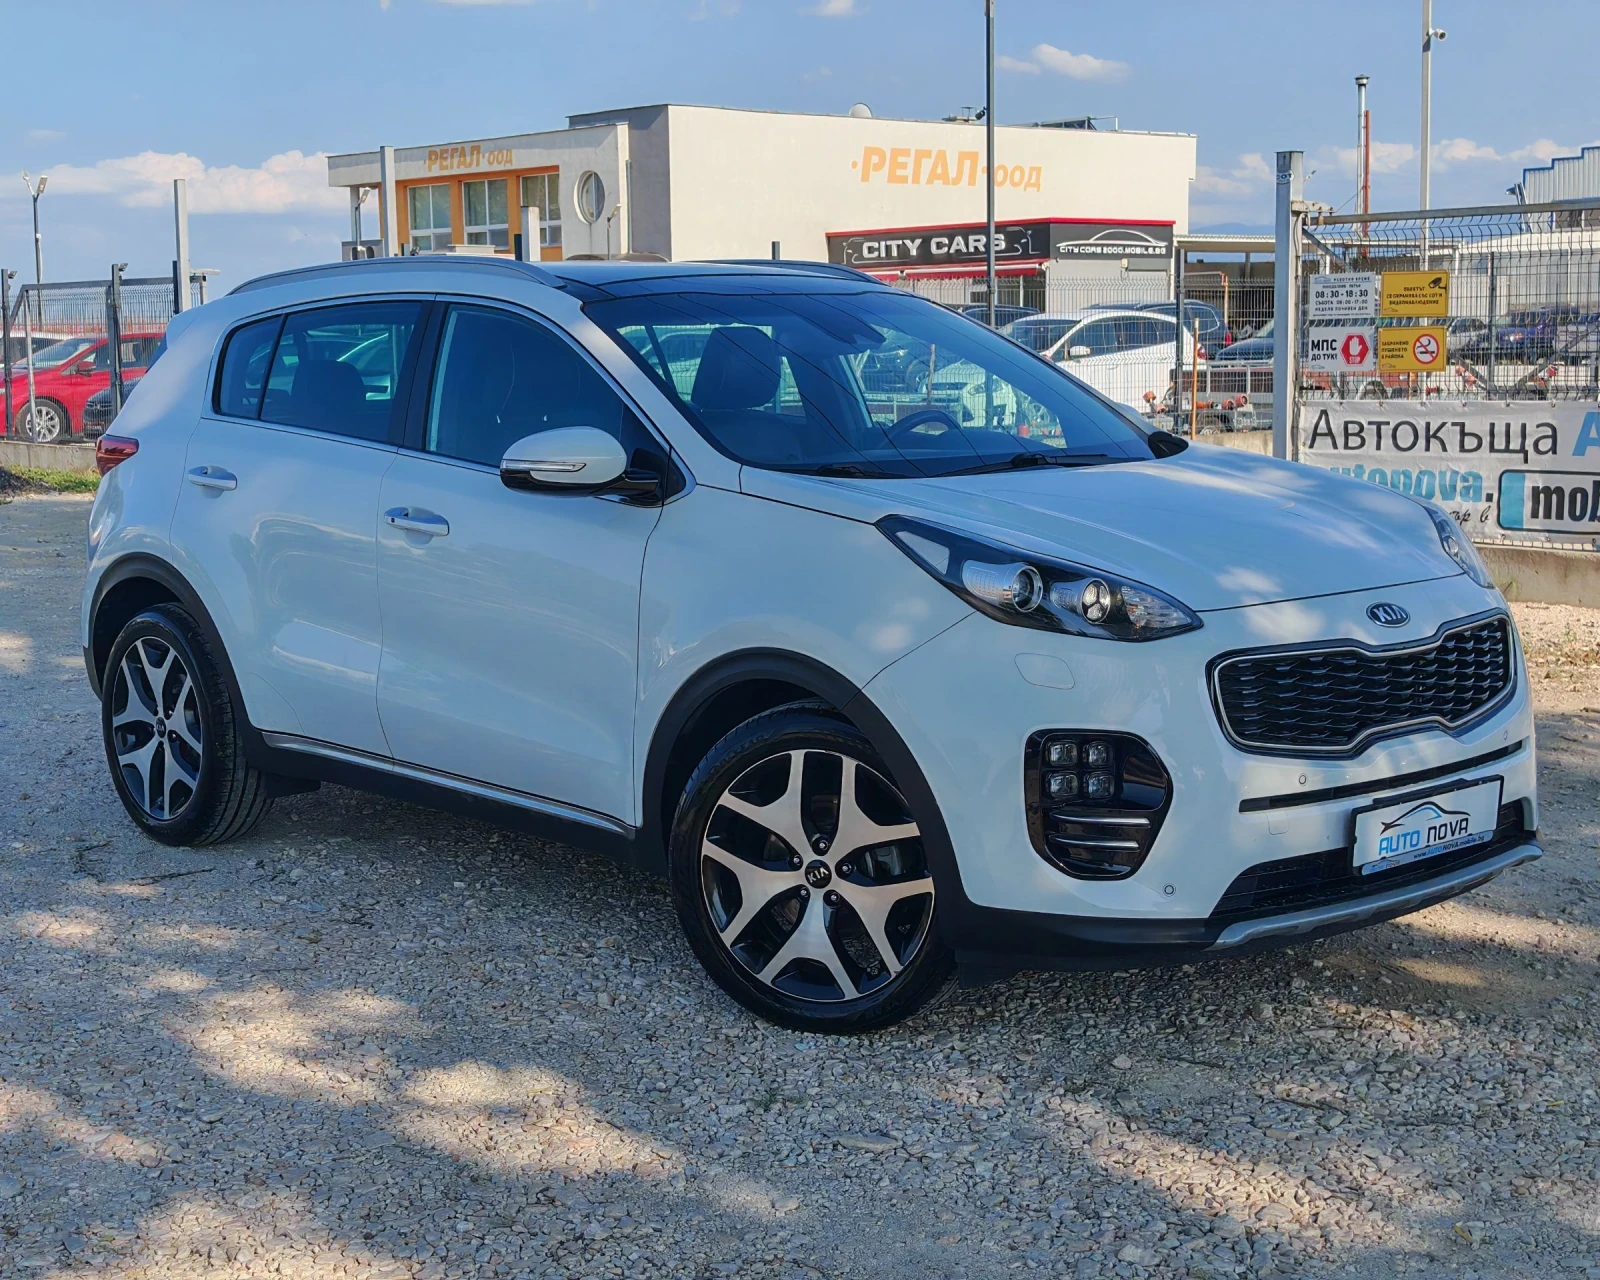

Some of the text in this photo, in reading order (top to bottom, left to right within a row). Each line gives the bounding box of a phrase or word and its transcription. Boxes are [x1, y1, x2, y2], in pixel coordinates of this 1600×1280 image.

[860, 146, 980, 187] РЕГАЛ
[862, 232, 1006, 259] CITY CARS
[1311, 339, 1337, 352] МПС
[1311, 354, 1322, 362] ДО
[1308, 409, 1558, 464] Автокъща
[1372, 604, 1407, 622] KIA
[1378, 817, 1469, 856] AUTO NOVA
[807, 867, 829, 883] KIA
